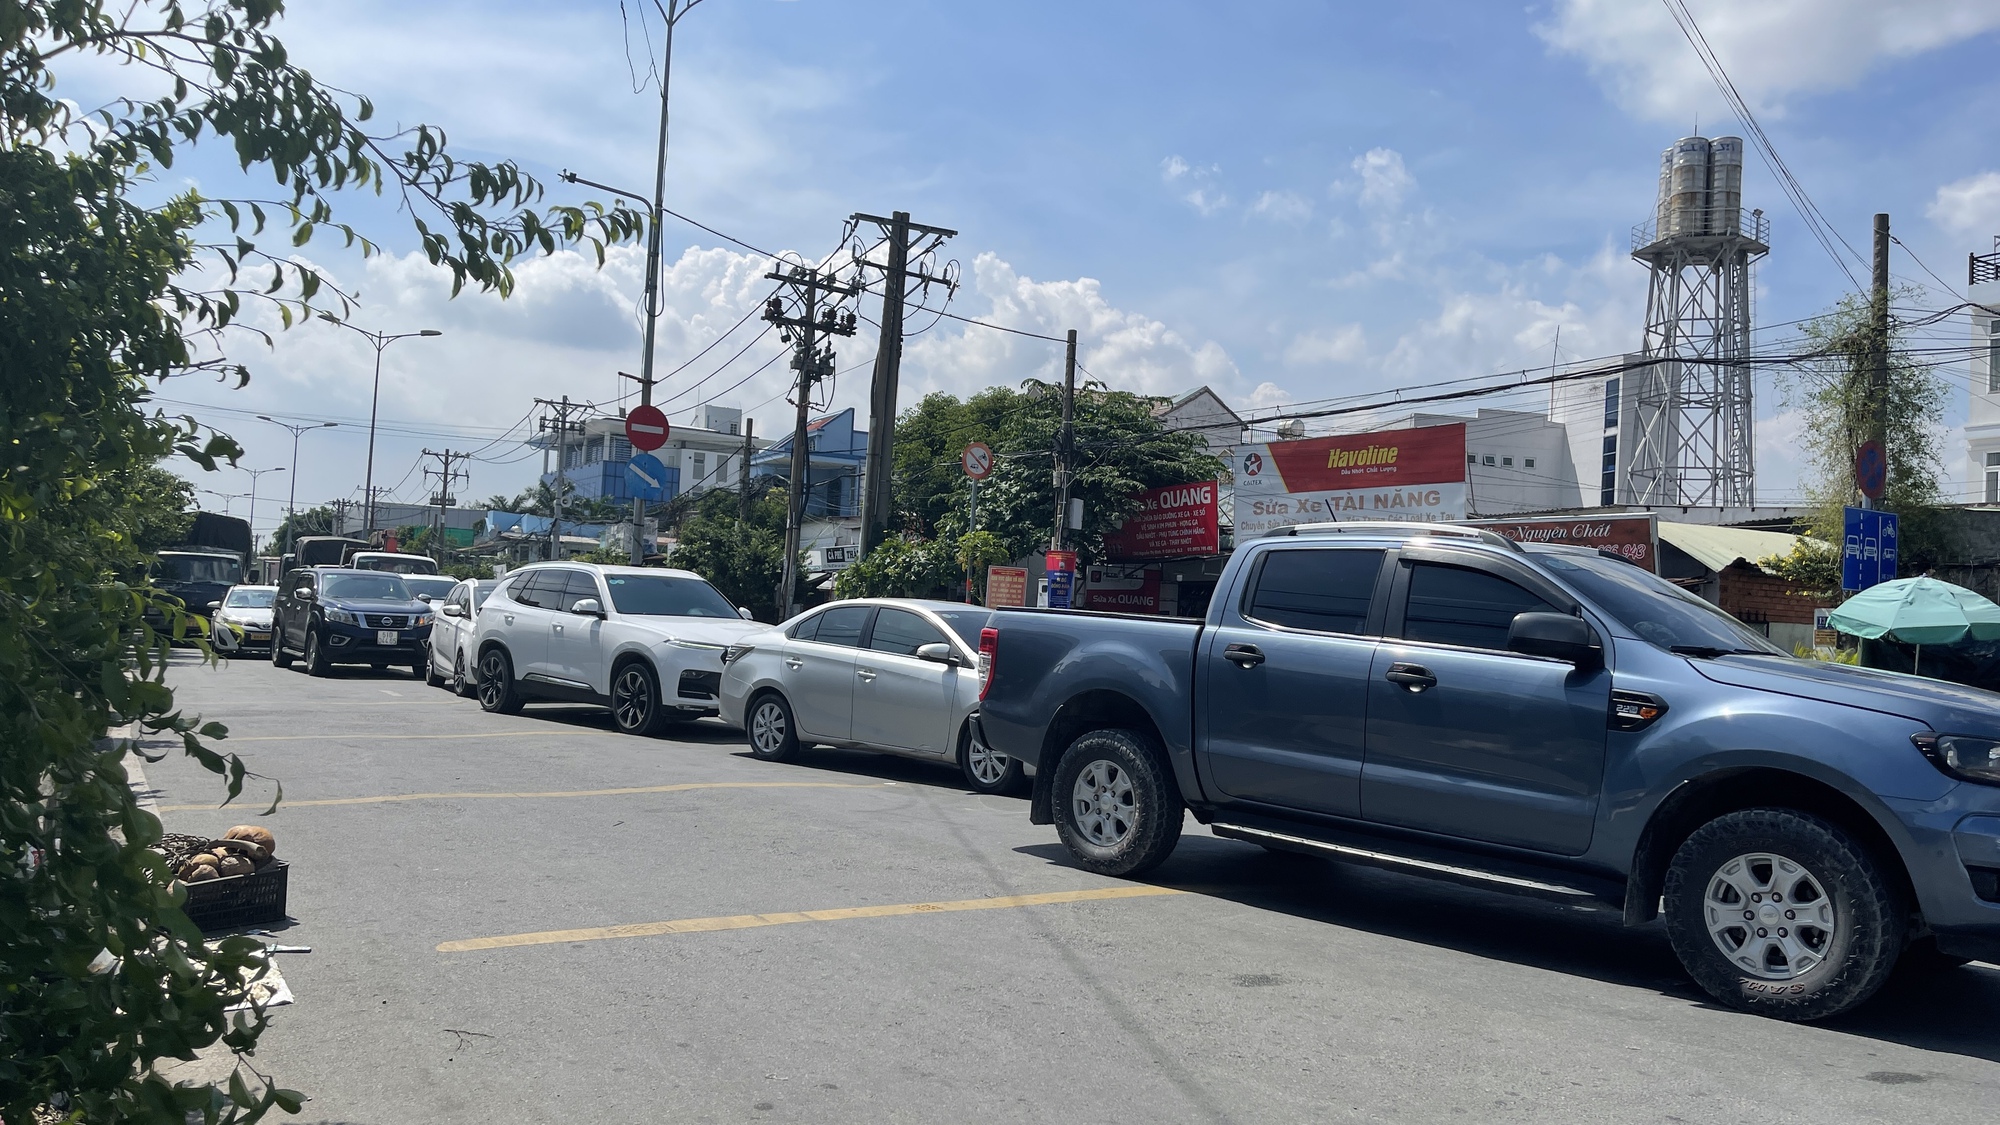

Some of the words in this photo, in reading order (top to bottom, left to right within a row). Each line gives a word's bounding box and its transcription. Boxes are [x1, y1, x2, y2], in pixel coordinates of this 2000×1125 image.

[1327, 444, 1398, 469] Havoline
[1146, 498, 1158, 510] Xe
[1160, 486, 1211, 508] QUANG
[1252, 498, 1288, 516] Sửa
[1295, 499, 1321, 513] Xe
[1330, 492, 1364, 511] TÀI
[1373, 488, 1441, 510] NĂNG
[1240, 520, 1265, 531] Chuyên
[1505, 525, 1569, 543] Nguyên
[1572, 522, 1612, 539] Chất
[1117, 594, 1154, 606] QUANG
